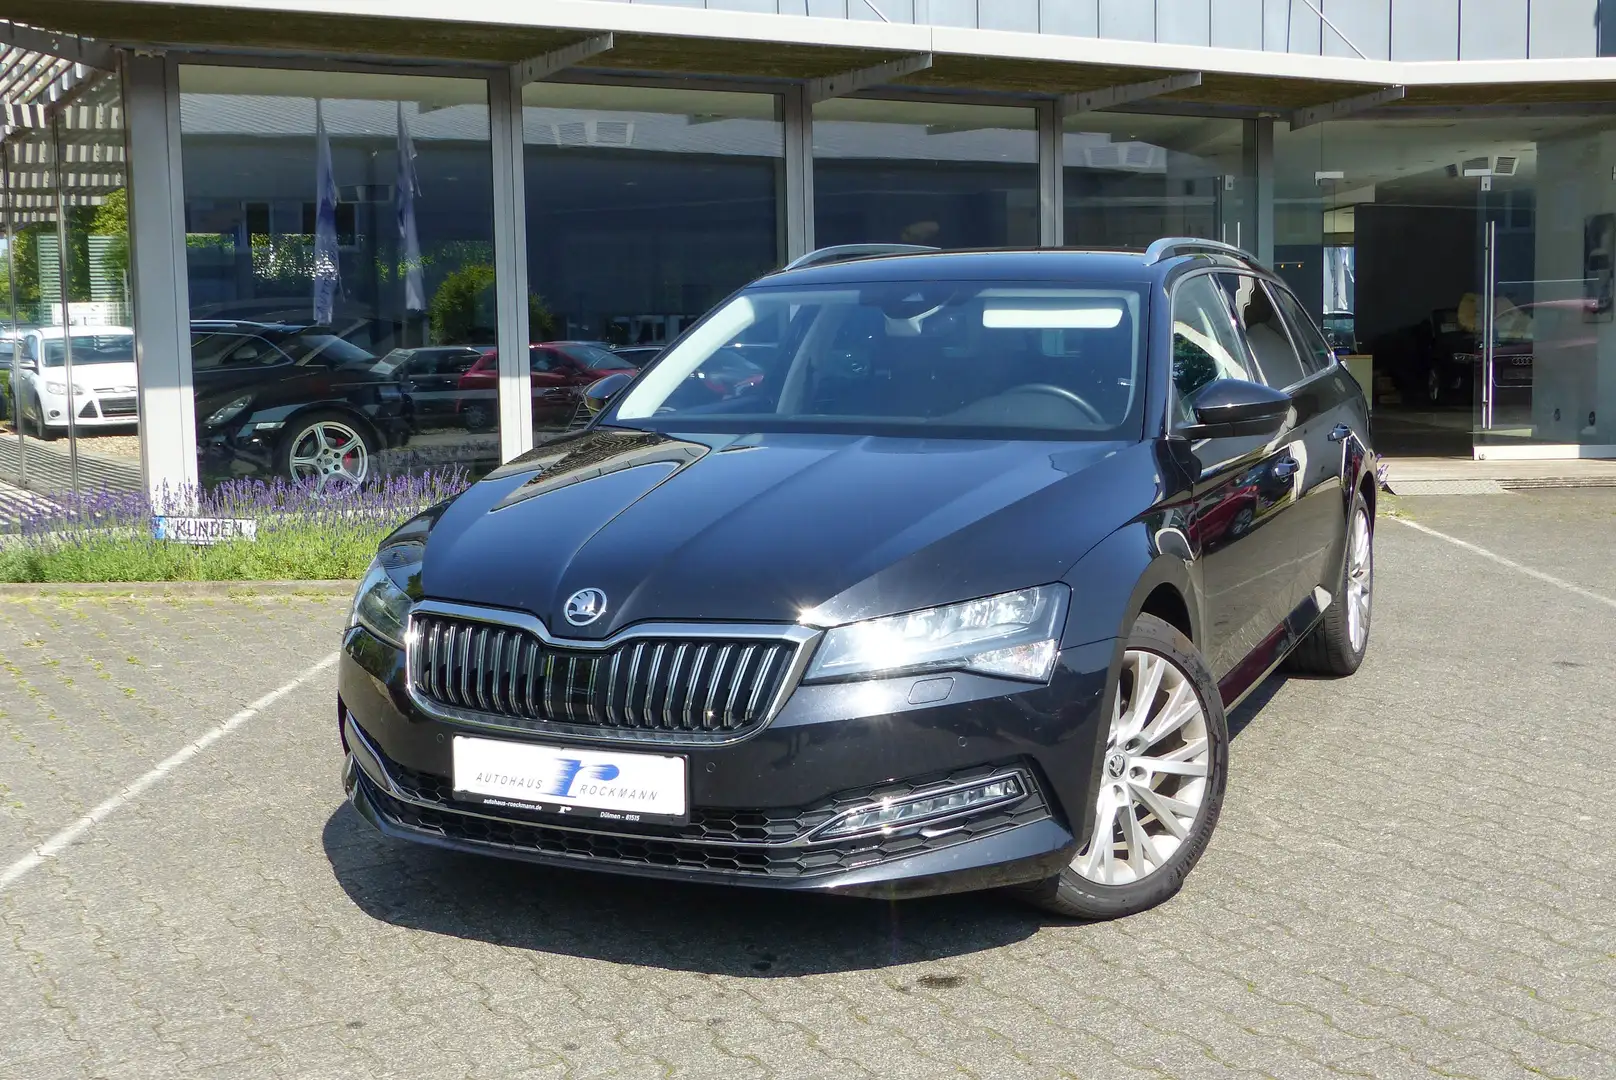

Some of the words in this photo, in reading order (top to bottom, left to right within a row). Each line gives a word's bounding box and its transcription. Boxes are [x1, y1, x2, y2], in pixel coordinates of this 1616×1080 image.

[175, 519, 243, 537] KUNDEN
[476, 772, 543, 789] AUTOHAUS
[579, 784, 658, 801] ROCKMANN
[483, 798, 542, 811] autohaus-roeckmann.de
